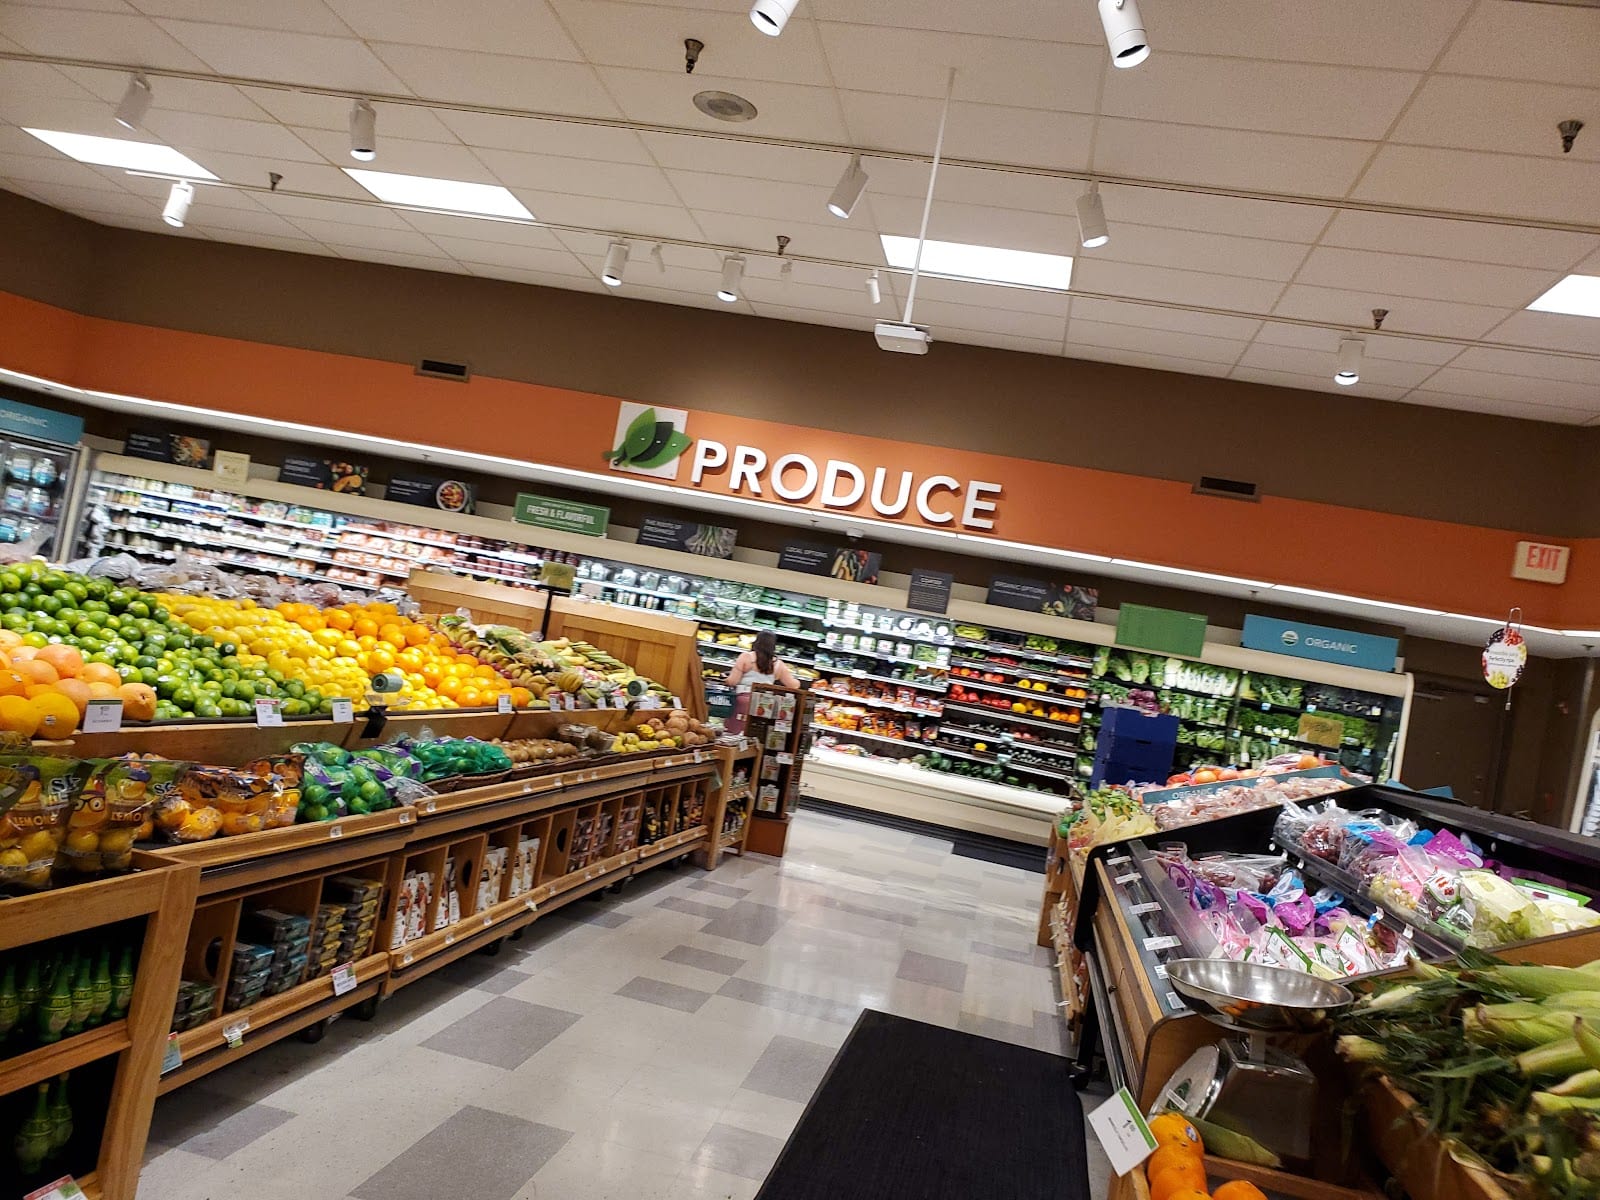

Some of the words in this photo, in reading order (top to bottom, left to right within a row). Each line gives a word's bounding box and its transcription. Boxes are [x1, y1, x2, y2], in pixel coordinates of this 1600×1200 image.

[690, 439, 1002, 529] PRODUCE
[526, 504, 550, 517] FRESH
[556, 509, 596, 525] FLAVORFUL
[1525, 545, 1562, 572] EXIT
[1304, 637, 1358, 654] ORGANIC
